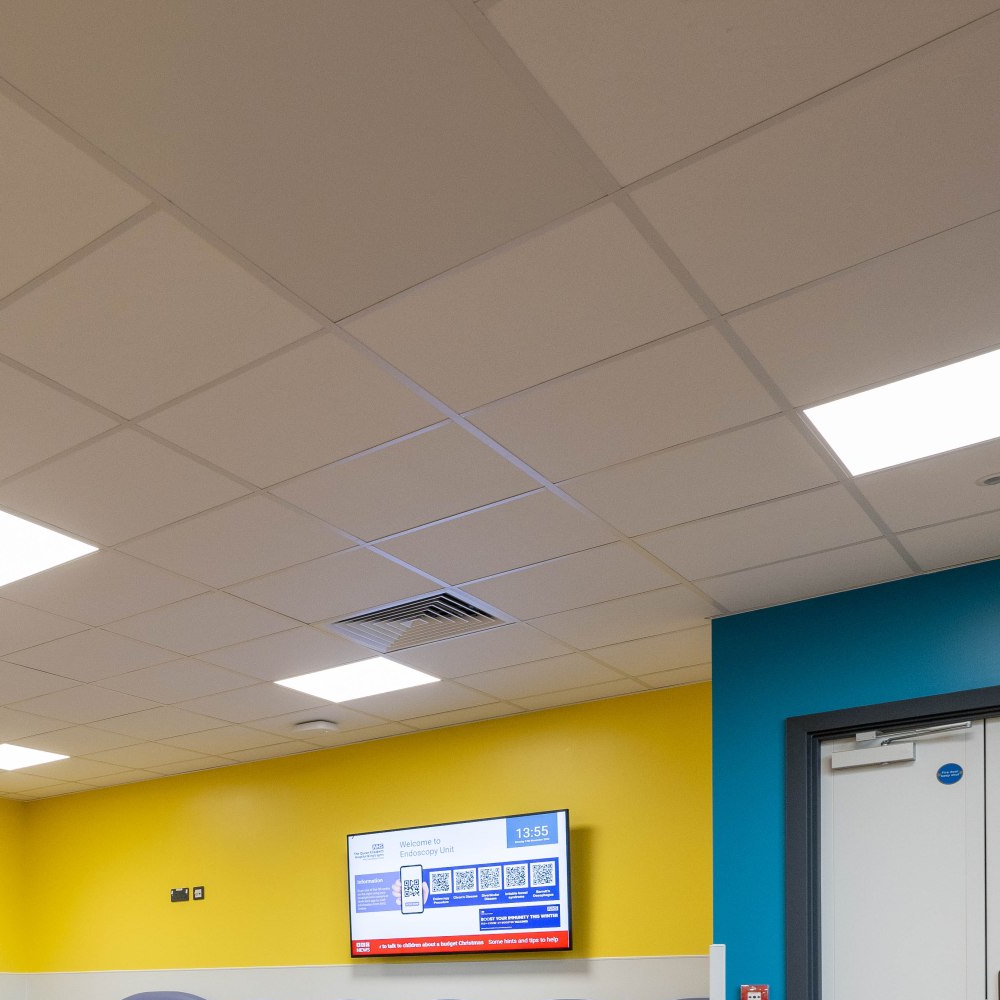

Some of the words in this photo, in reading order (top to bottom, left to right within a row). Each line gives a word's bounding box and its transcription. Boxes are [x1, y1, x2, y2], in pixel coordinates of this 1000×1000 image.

[516, 825, 549, 839] 13:55
[400, 840, 432, 848] Welcome
[400, 848, 438, 858] Endoscopy
[439, 846, 454, 854] Unit
